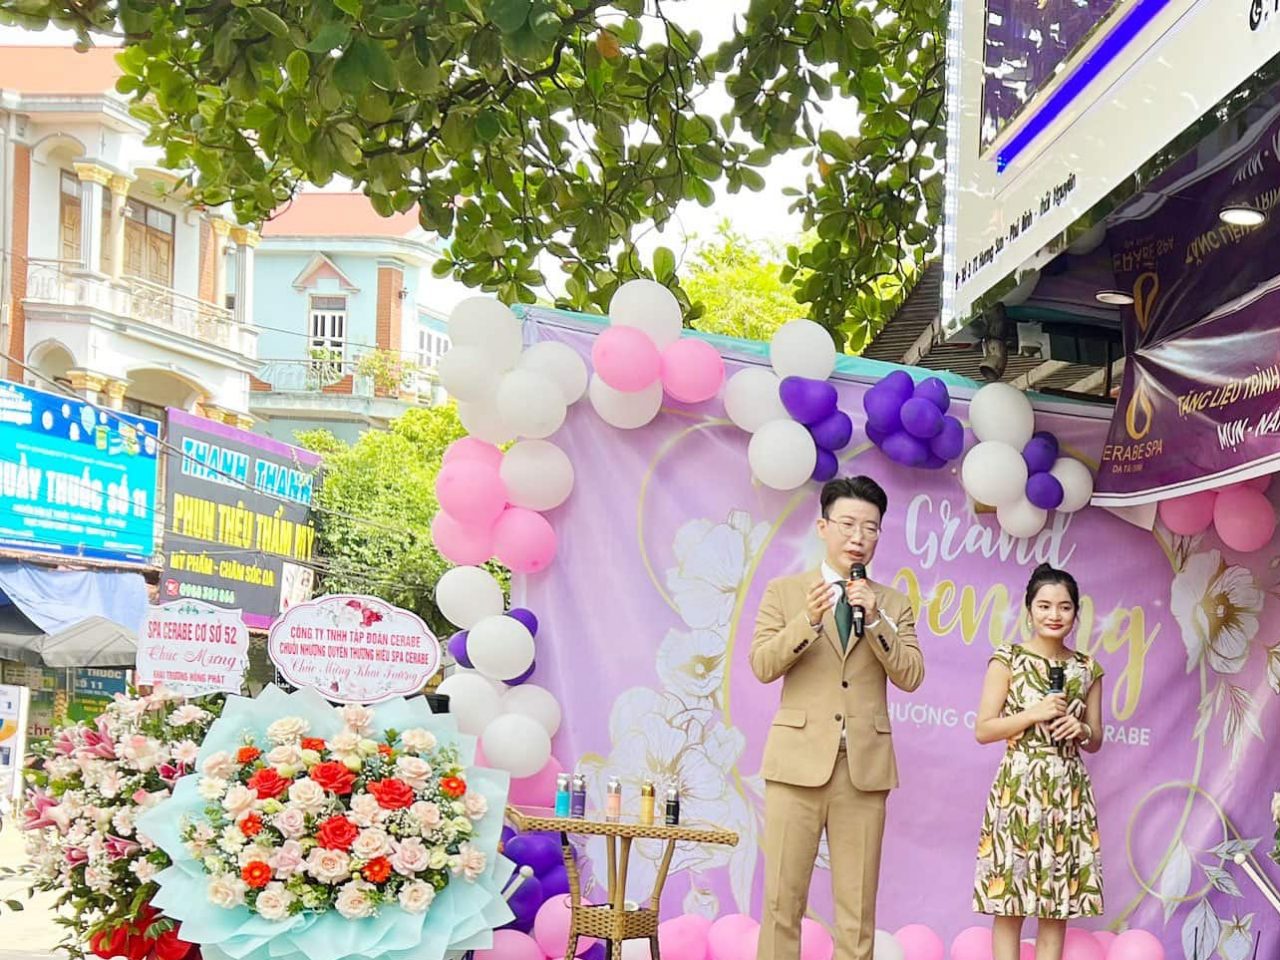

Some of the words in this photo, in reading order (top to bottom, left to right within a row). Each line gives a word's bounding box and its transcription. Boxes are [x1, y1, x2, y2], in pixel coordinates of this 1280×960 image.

[1243, 367, 1280, 400] TRÌNH
[1217, 418, 1249, 453] MỤN
[173, 492, 217, 541] PHUN
[224, 626, 238, 644] 52
[327, 629, 347, 642] TNHH
